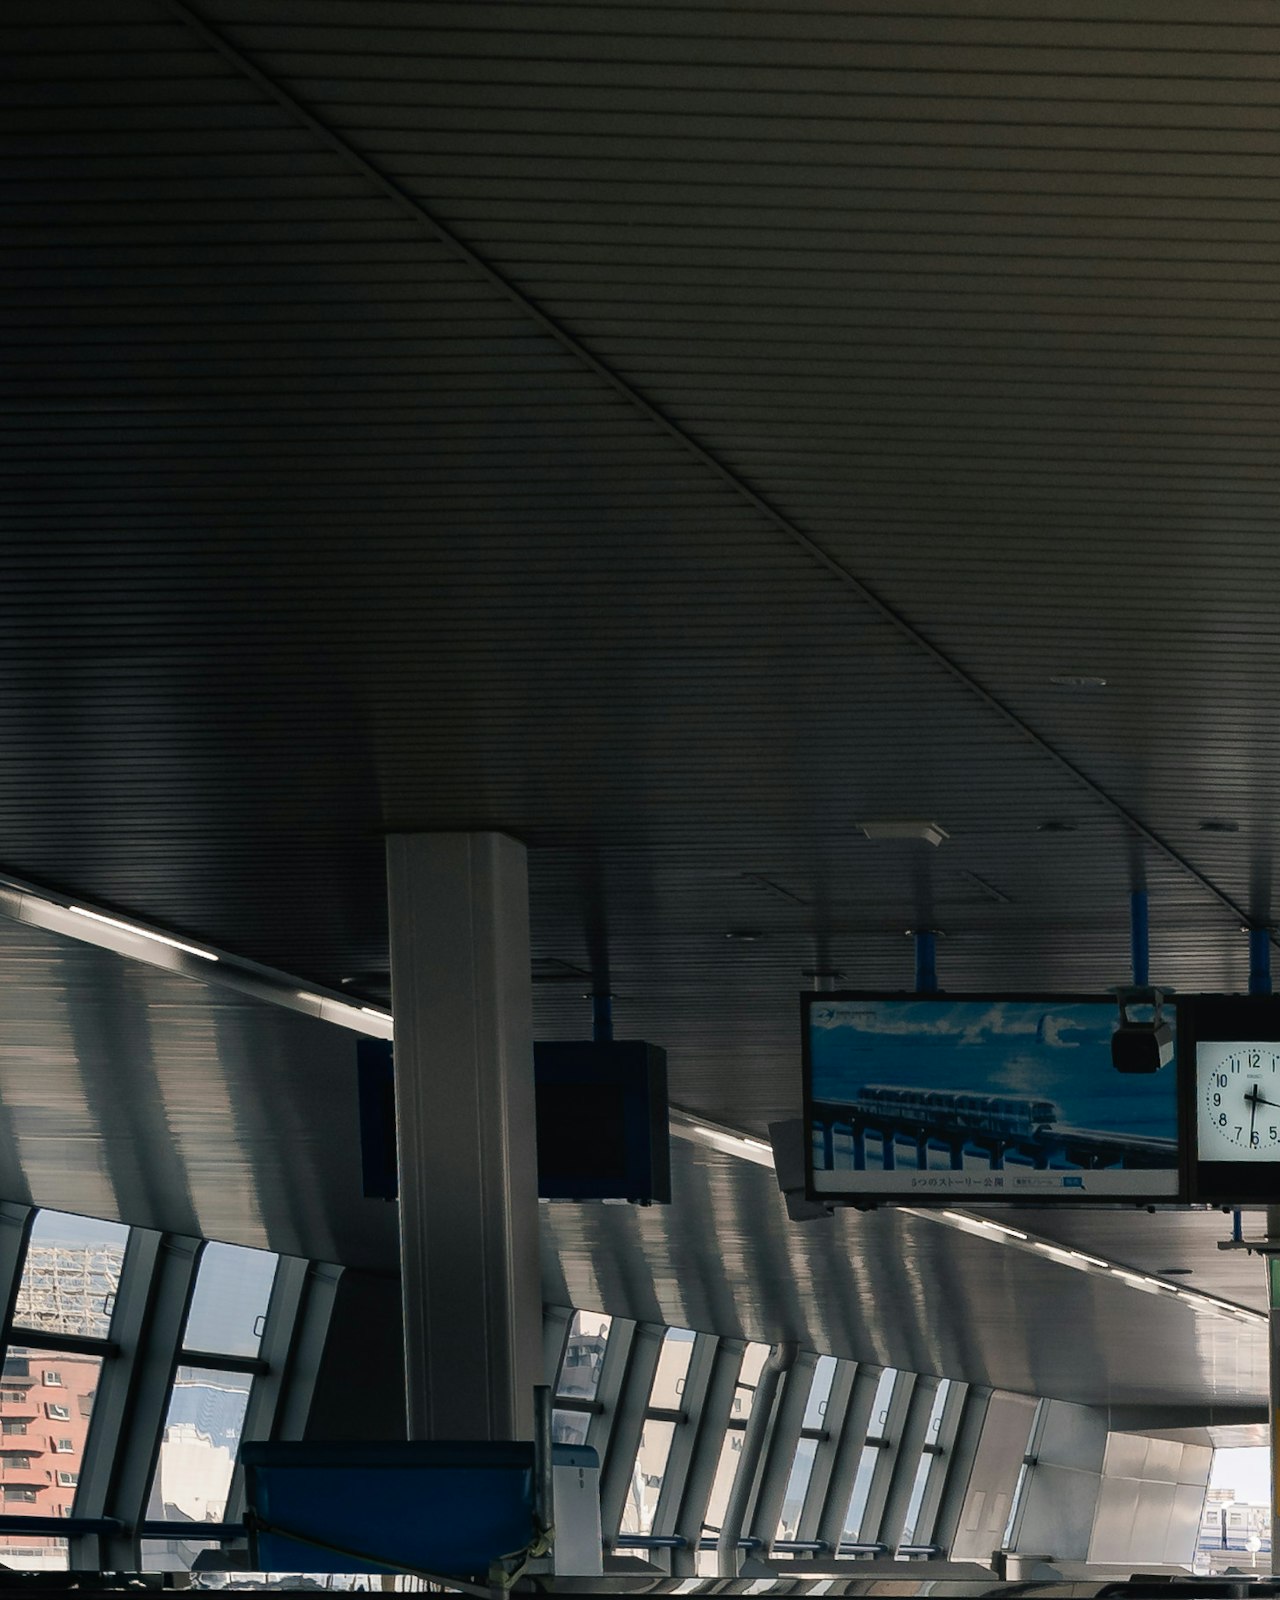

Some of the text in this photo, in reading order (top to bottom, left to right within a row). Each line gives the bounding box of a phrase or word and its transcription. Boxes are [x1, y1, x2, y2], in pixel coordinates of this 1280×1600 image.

[1231, 1059, 1240, 1073] 11
[1248, 1053, 1260, 1068] 12
[1216, 1073, 1228, 1088] 10
[1213, 1093, 1221, 1107] 9
[1219, 1113, 1227, 1126] 8
[1234, 1126, 1242, 1140] 7
[1251, 1131, 1260, 1145] 6
[1269, 1126, 1277, 1140] 5
